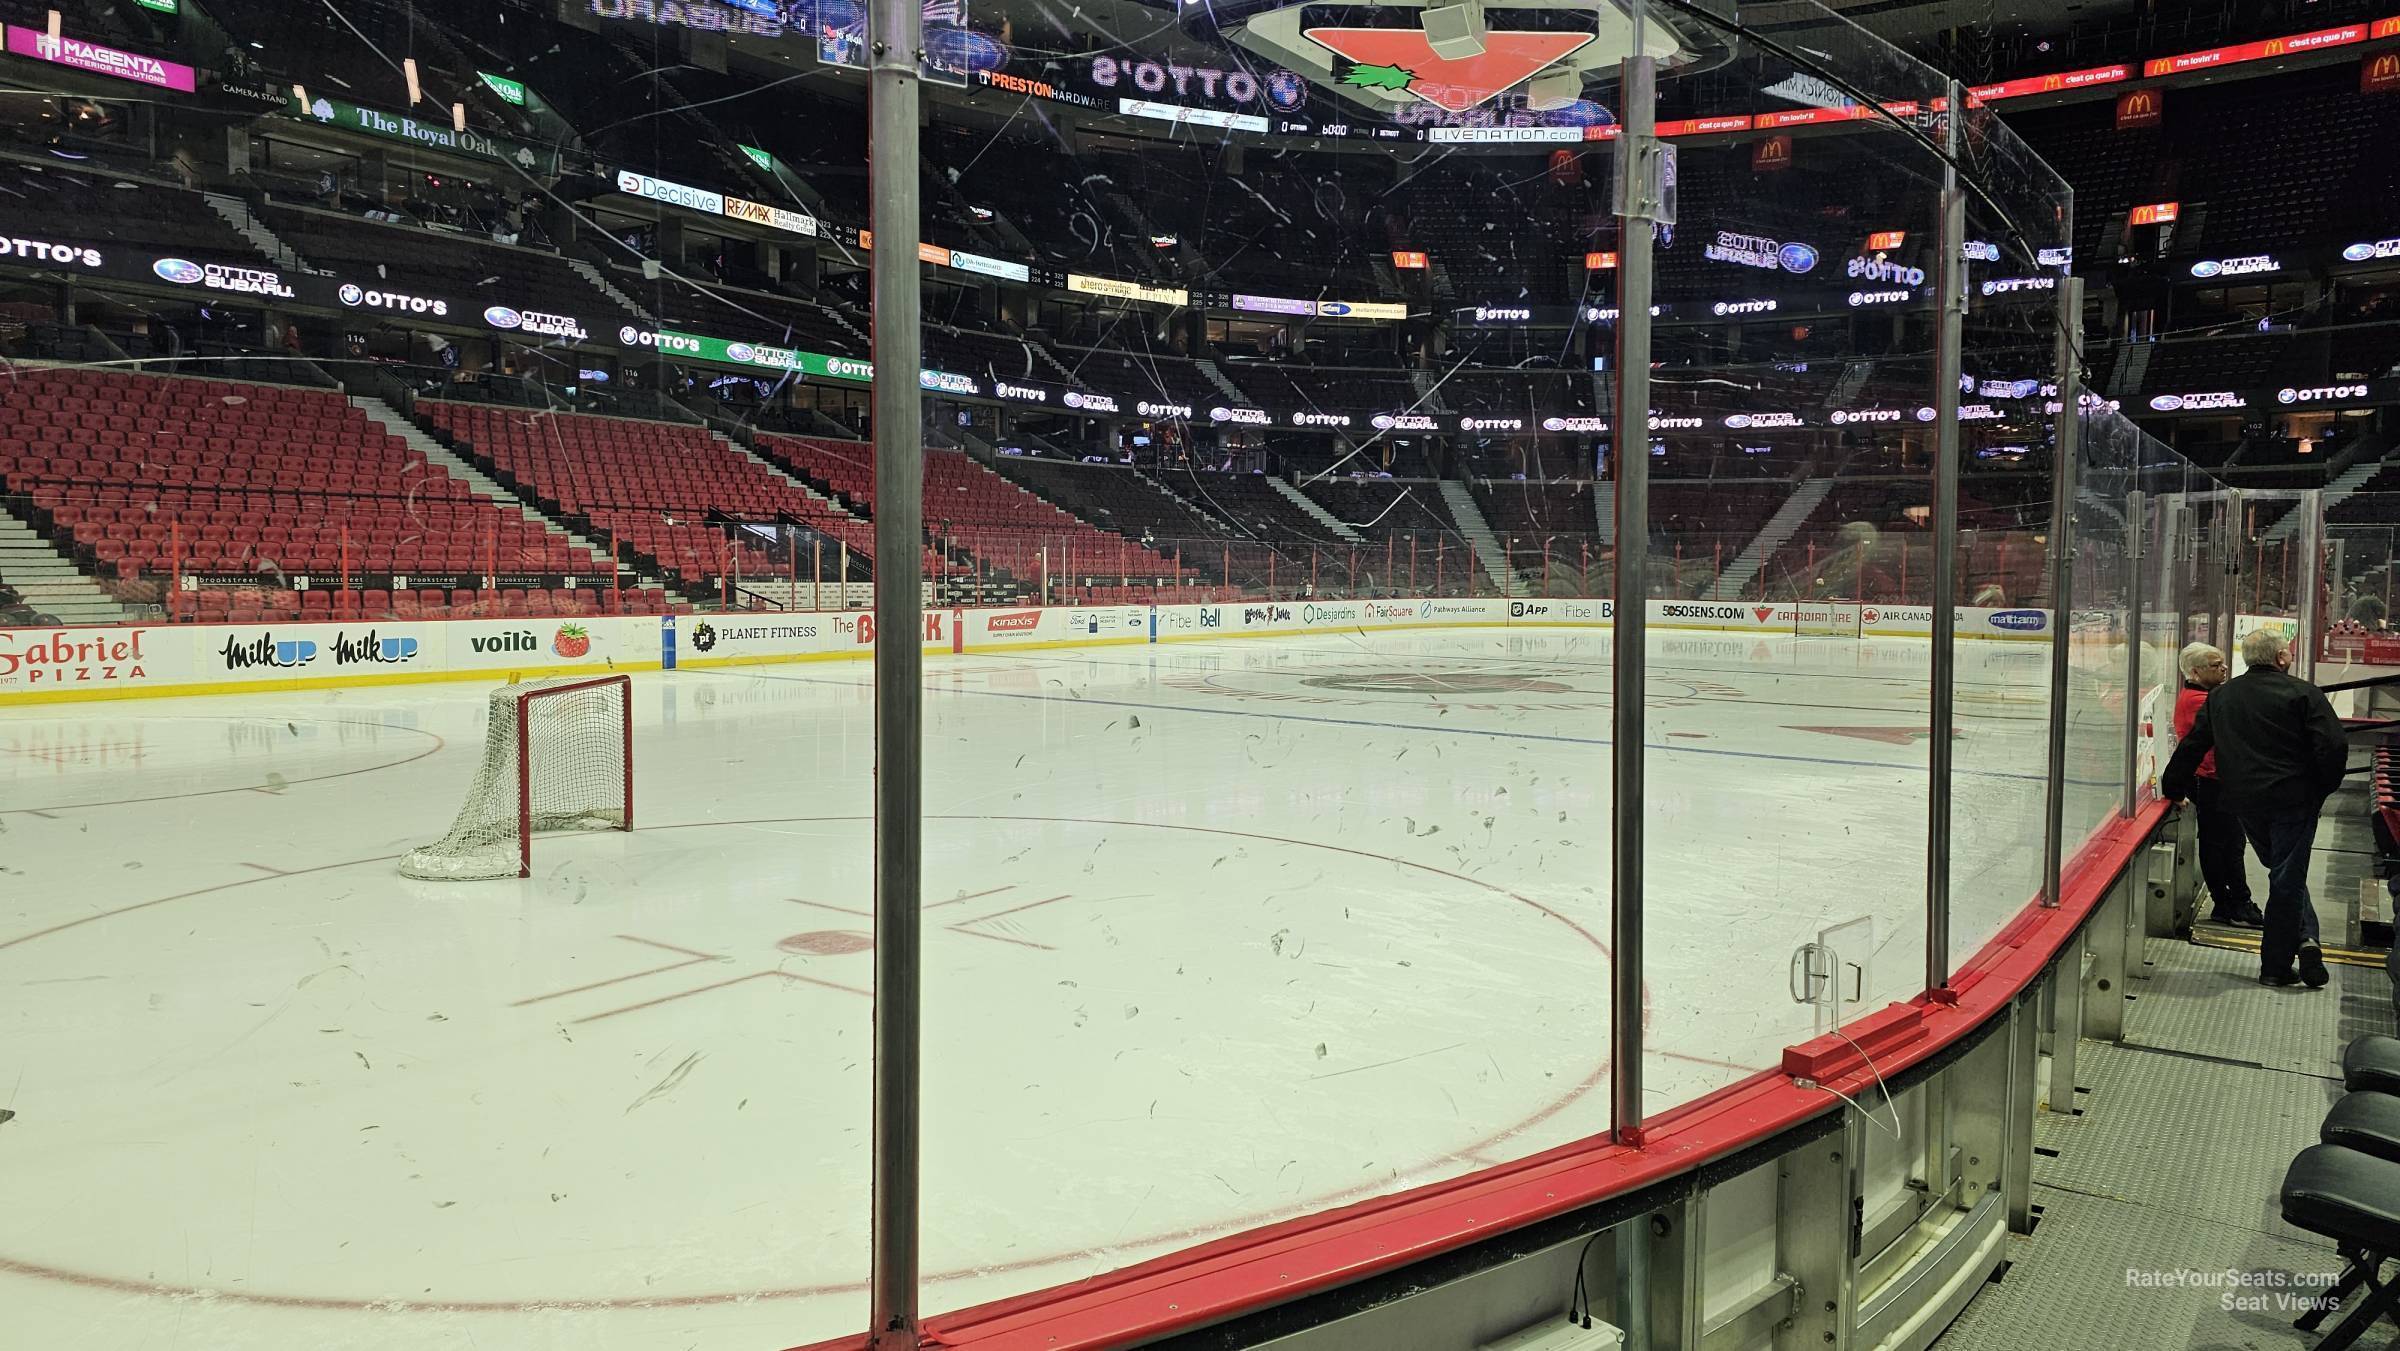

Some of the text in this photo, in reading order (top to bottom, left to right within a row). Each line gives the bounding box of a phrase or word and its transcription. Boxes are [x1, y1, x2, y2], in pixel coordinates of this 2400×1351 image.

[64, 40, 166, 77] MAGENTA
[64, 56, 166, 84] EXTERIOR SOLUTIONS
[222, 84, 288, 105] CAMERA STAND
[356, 107, 498, 157] The Royal Oak
[1432, 128, 1581, 142] LIVENATION.com
[643, 178, 717, 211] Decisive
[727, 198, 771, 223] RE/MAX
[774, 209, 814, 228] Hallmark
[774, 218, 815, 236] Realty Group
[845, 227, 857, 236] 324
[845, 237, 857, 246] 224
[204, 263, 278, 284] OTTO'S
[1863, 291, 1909, 303] OTTO'S
[365, 293, 447, 316] OTTO'S
[1728, 301, 1776, 313] OTTO'S
[522, 311, 576, 328] OTTO'S
[1487, 309, 1529, 320] OTTO'S
[347, 334, 365, 344] 116
[639, 332, 700, 353] OTTO'S
[624, 368, 637, 377] 116
[1008, 387, 1045, 401] OTTO'S
[2299, 386, 2367, 400] OTTO'S
[1150, 404, 1192, 417] OTTO'S
[1848, 411, 1900, 422] OTTO'S
[1306, 415, 1350, 426] OTTO'S
[1474, 419, 1522, 429] OTTO'S
[1661, 418, 1702, 428] OTTO'S
[199, 575, 258, 584] brookstreet
[1274, 606, 1290, 621] Juice
[1317, 606, 1355, 620] Desjardins
[1376, 605, 1413, 617] FairSquare
[1434, 605, 1486, 613] Pathways Alliance
[1565, 604, 1591, 617] Fibe
[1663, 605, 1744, 619] 5050SENS.COM
[1883, 612, 1900, 620] AIR
[1170, 608, 1220, 628] Fibe Bell
[832, 617, 854, 634] The
[699, 634, 710, 645] pf
[721, 627, 817, 640] PLANET FITNESS
[471, 630, 537, 653] voilà
[30, 665, 146, 683] PIZZA
